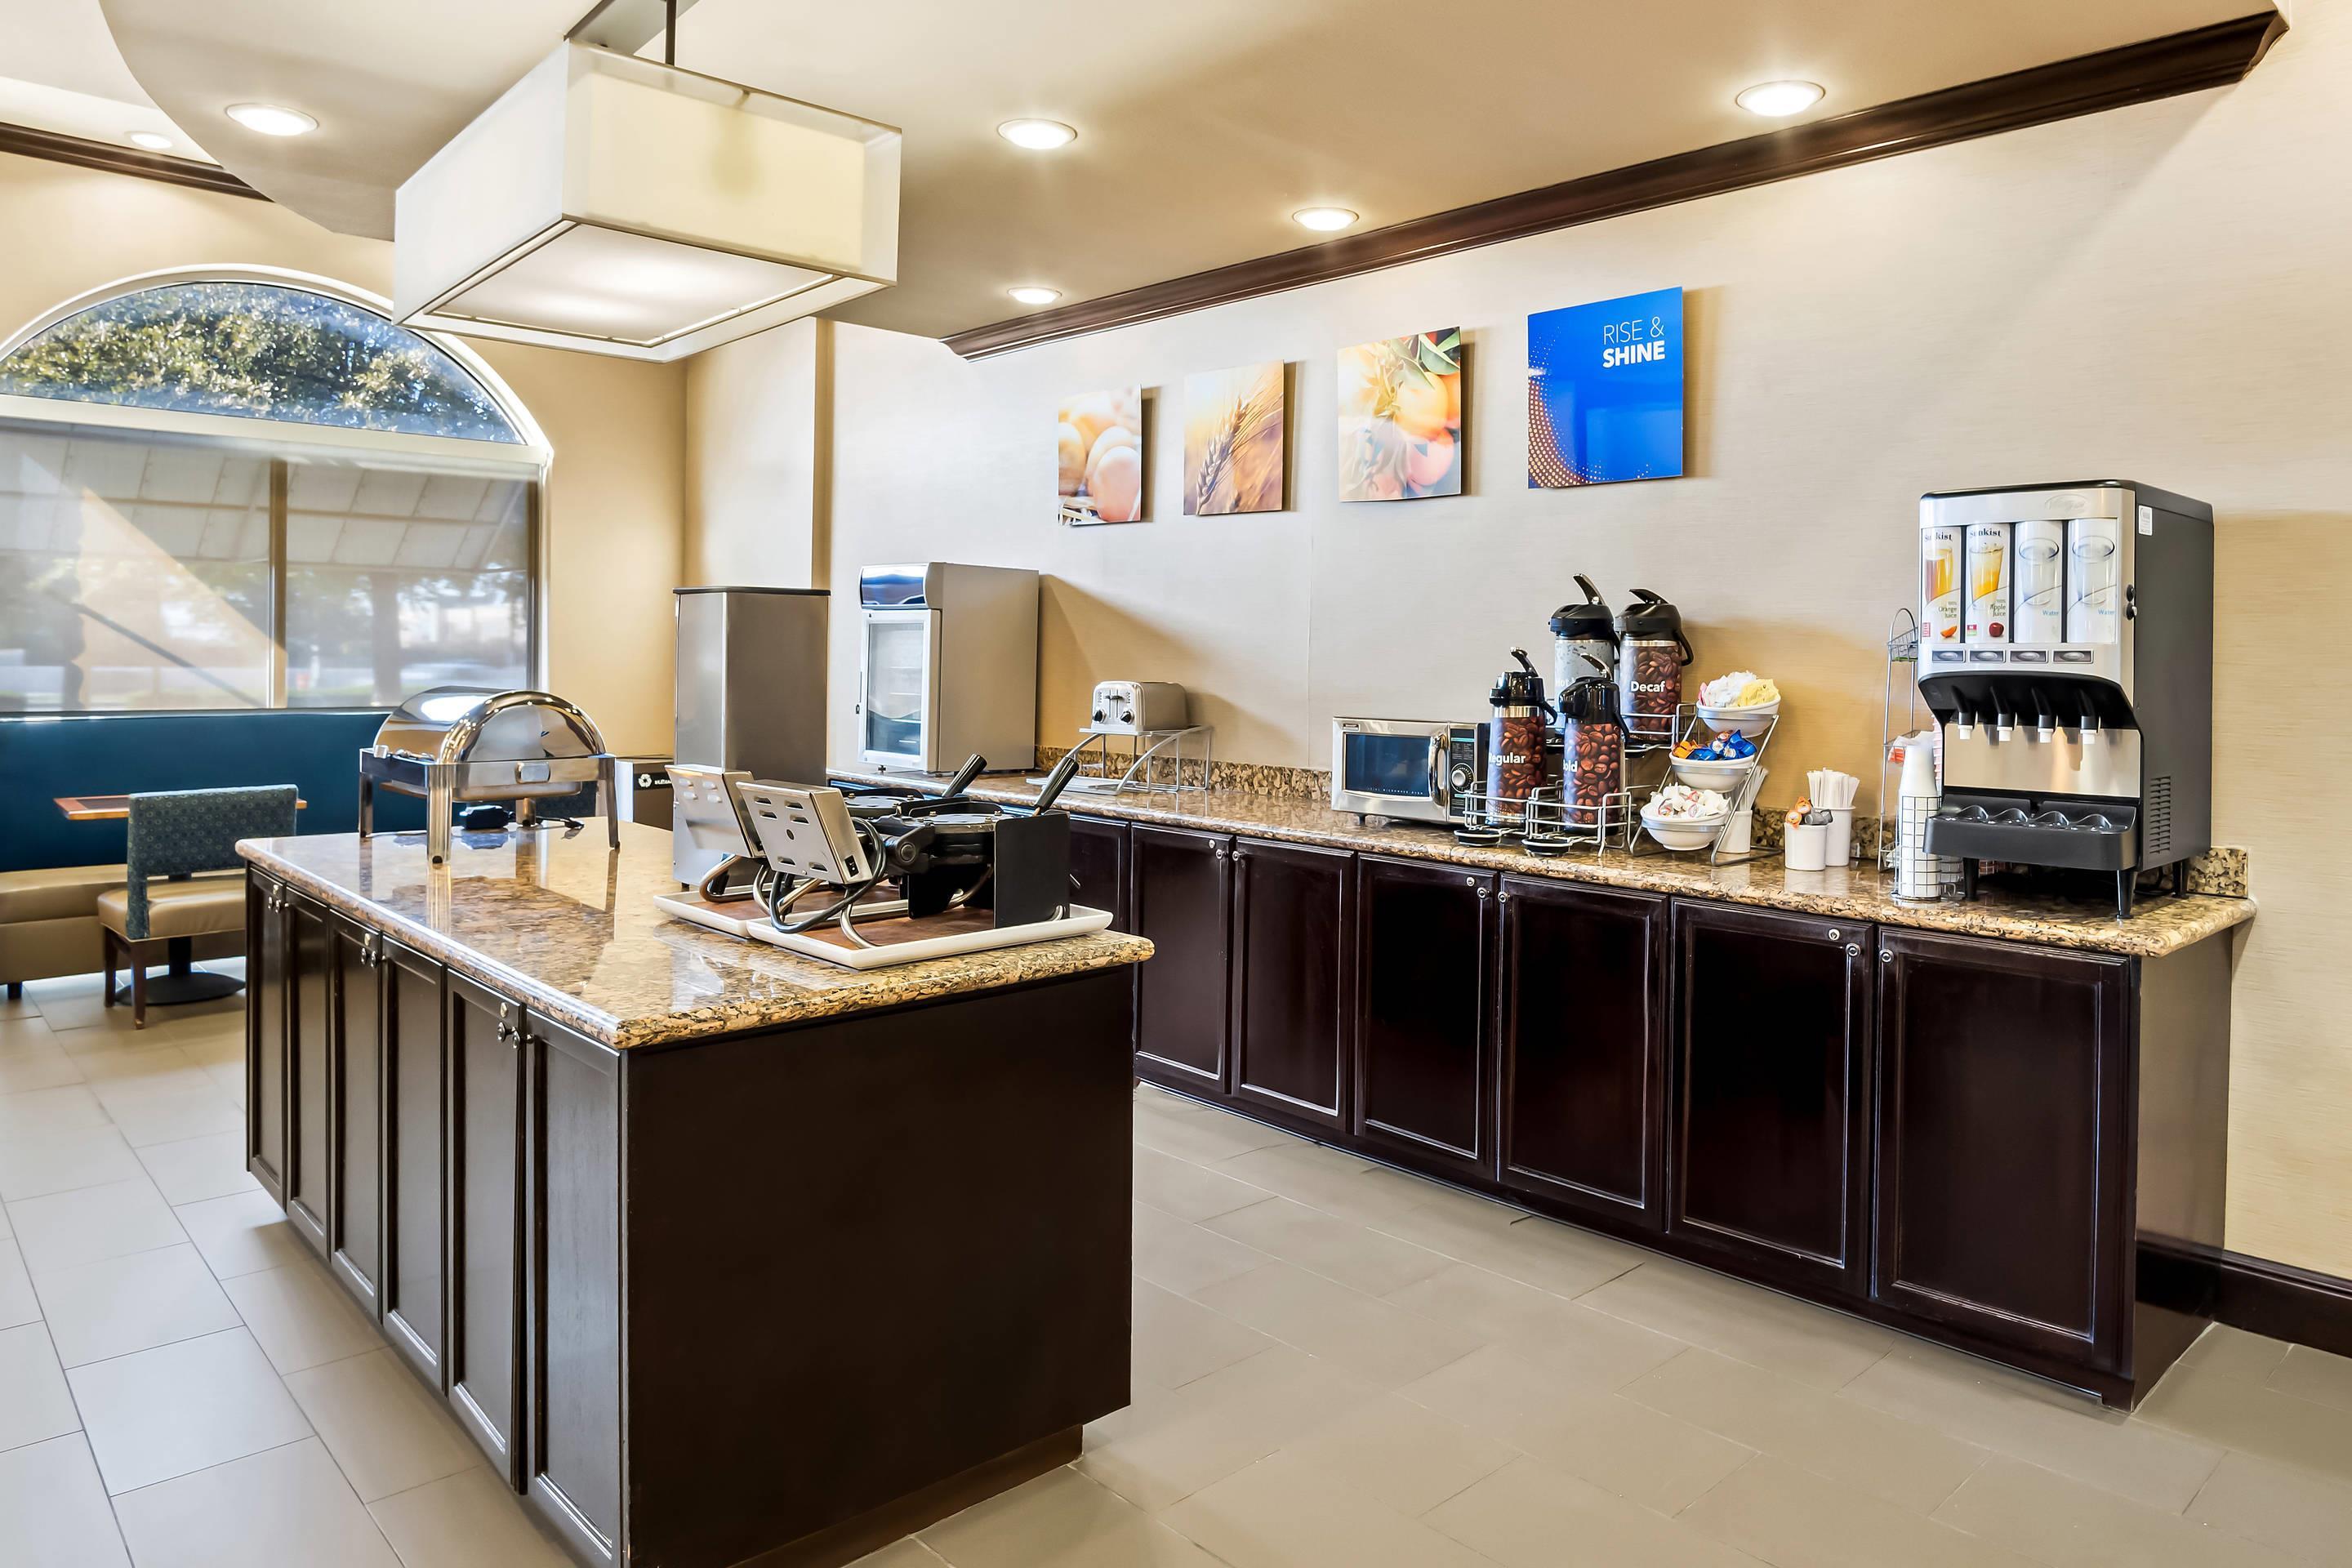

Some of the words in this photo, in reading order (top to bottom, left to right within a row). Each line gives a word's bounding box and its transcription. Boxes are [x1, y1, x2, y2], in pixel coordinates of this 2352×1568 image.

[1603, 319, 1643, 345] RISE
[1650, 316, 1665, 338] &
[1602, 340, 1666, 368] SHINE
[1630, 680, 1665, 693] Decaf
[1489, 751, 1526, 766] Regular
